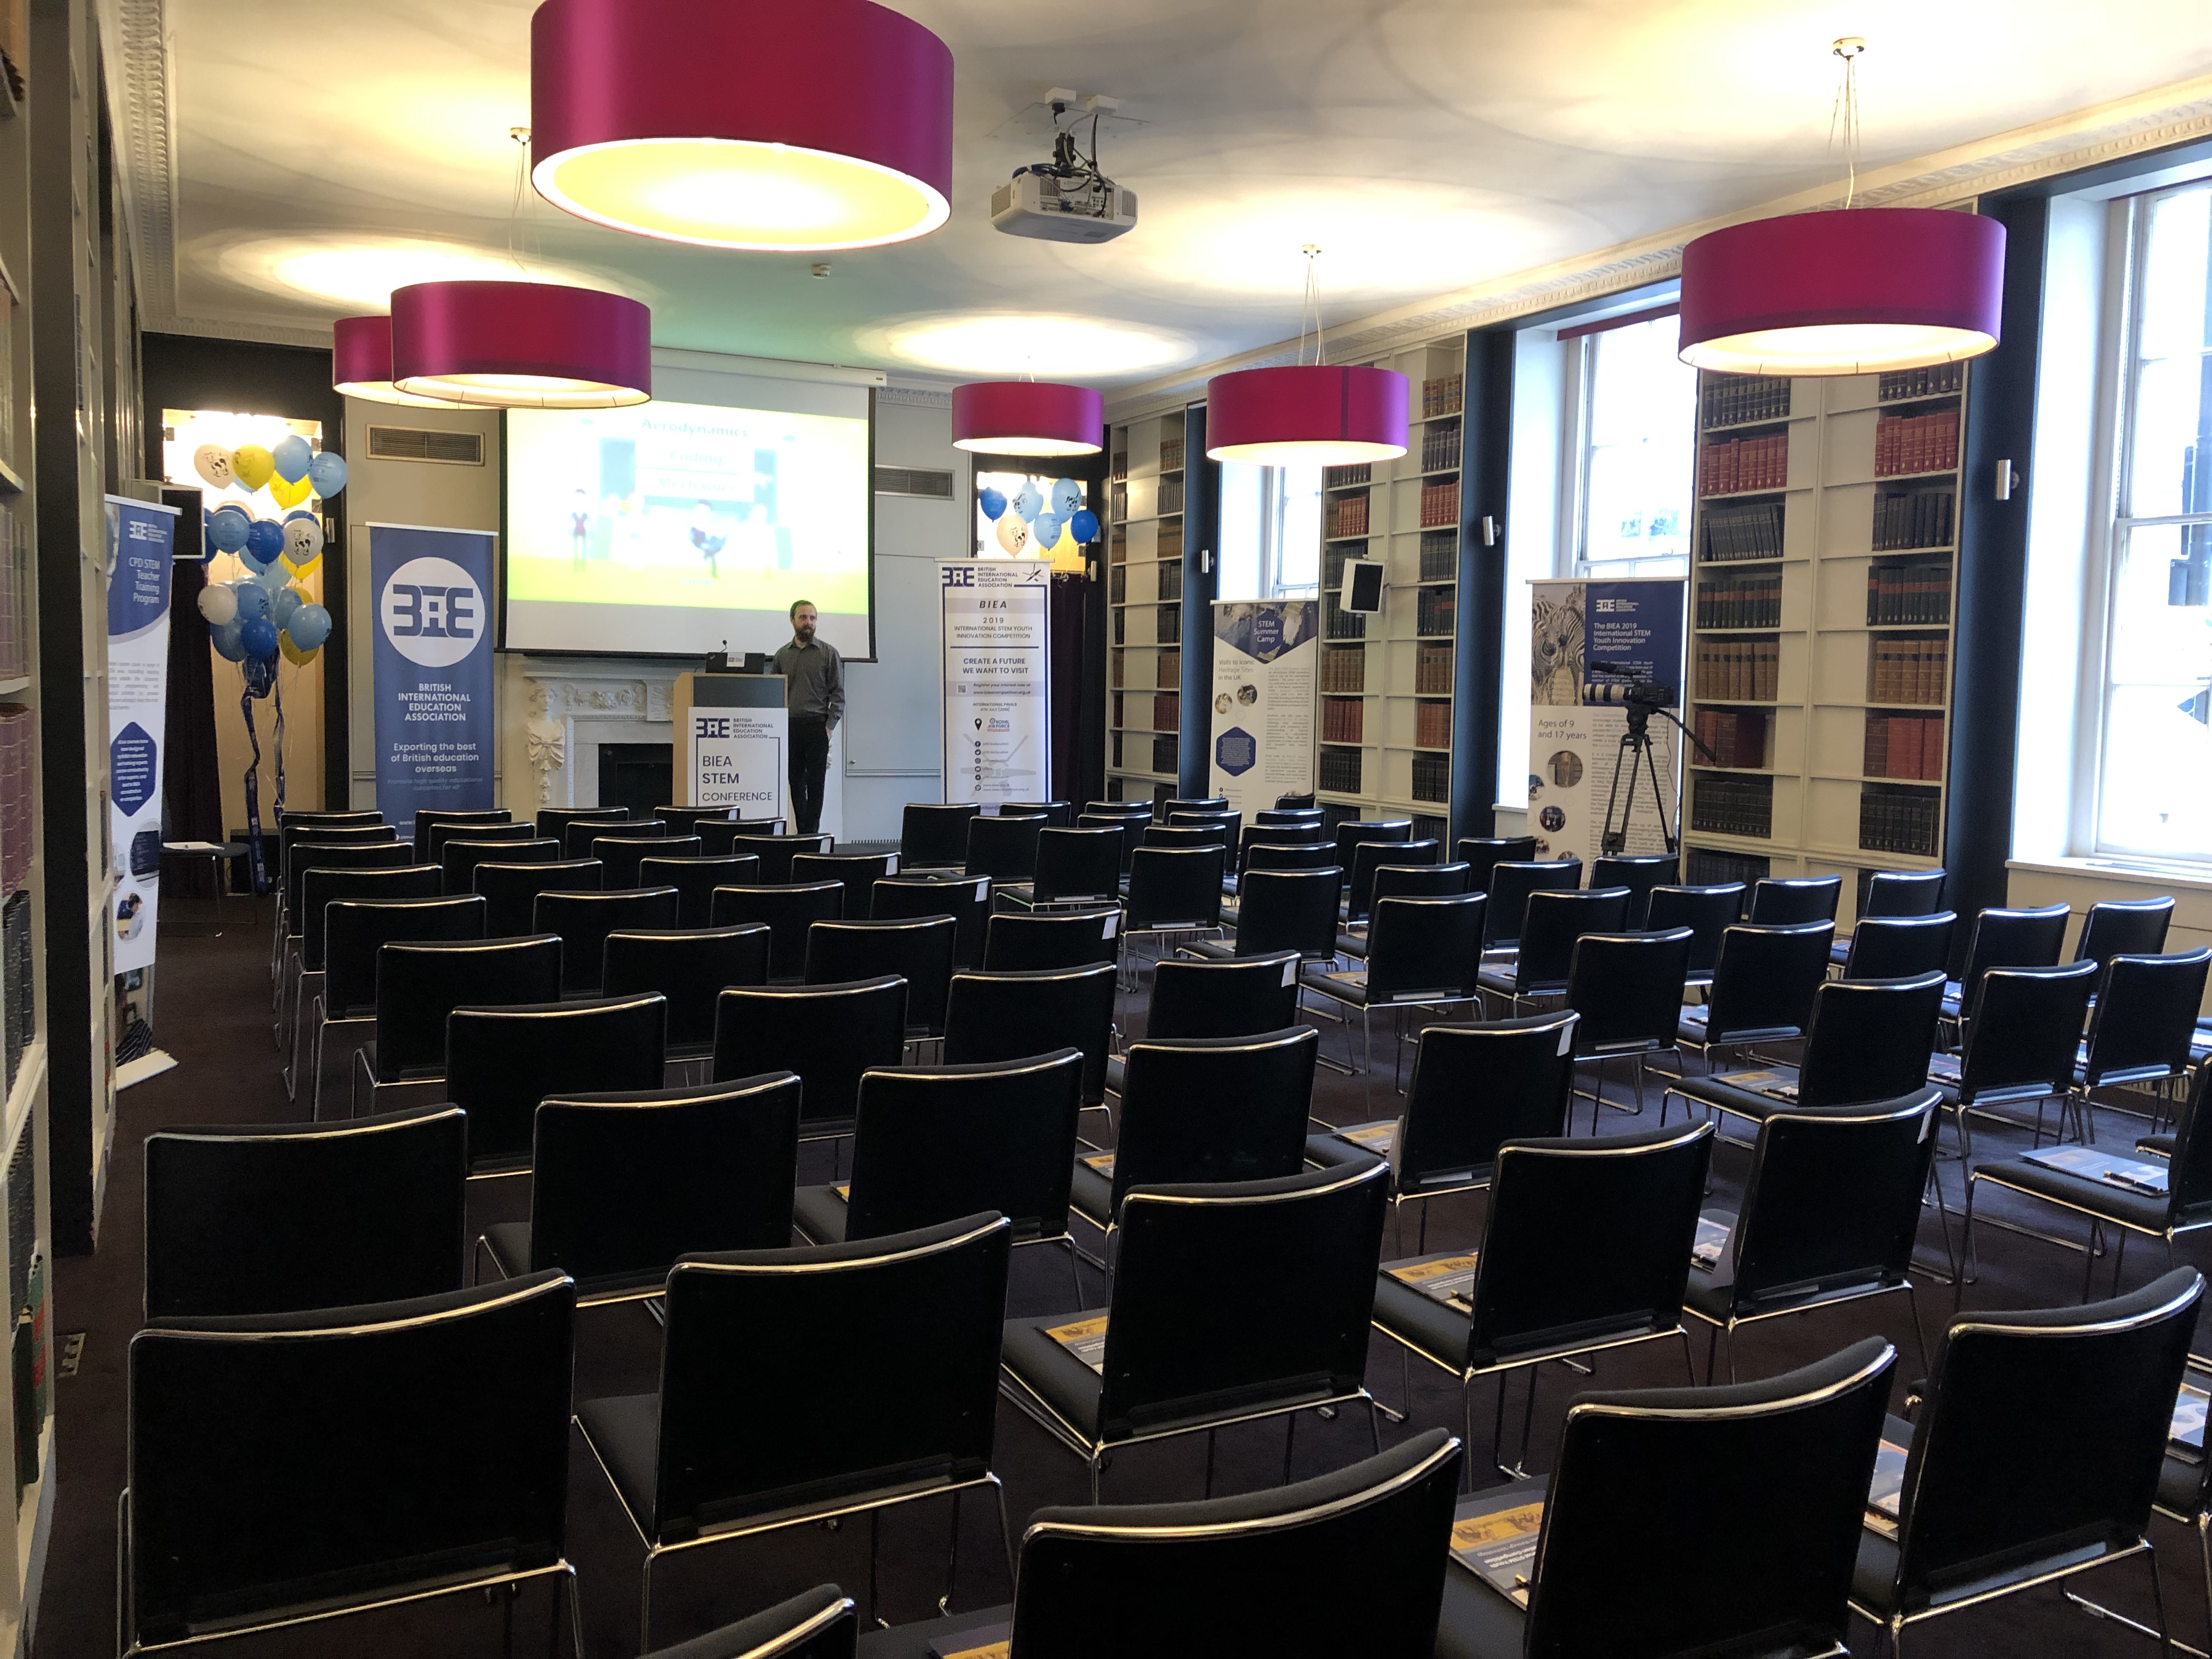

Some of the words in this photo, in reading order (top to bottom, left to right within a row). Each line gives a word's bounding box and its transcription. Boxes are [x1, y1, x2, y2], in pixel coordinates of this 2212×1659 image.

[641, 419, 747, 437] Aerodynamics
[669, 450, 723, 466] Coding
[128, 556, 143, 567] CPD
[144, 558, 161, 569] STEM
[136, 569, 160, 582] Teacher
[135, 581, 160, 595] Training
[132, 592, 160, 605] Program
[979, 600, 1007, 609] BIEA
[419, 683, 452, 692] BRITISH
[398, 692, 471, 702] INTERNATIONAL
[409, 703, 461, 712] EDUCATION
[404, 713, 466, 721] ASSOCIATION
[1538, 719, 1557, 729] Ages
[1559, 719, 1568, 728] of
[1569, 720, 1575, 728] 9
[1537, 730, 1553, 738] and
[1555, 731, 1564, 739] 17
[1566, 732, 1587, 741] years
[393, 742, 437, 753] Exporting
[439, 742, 455, 751] the
[456, 742, 476, 751] best
[391, 753, 400, 762] of
[402, 753, 431, 762] British
[433, 753, 479, 762] education
[702, 755, 733, 767] BIEA
[702, 772, 740, 784] STEM
[702, 792, 773, 802] CONFERENCE
